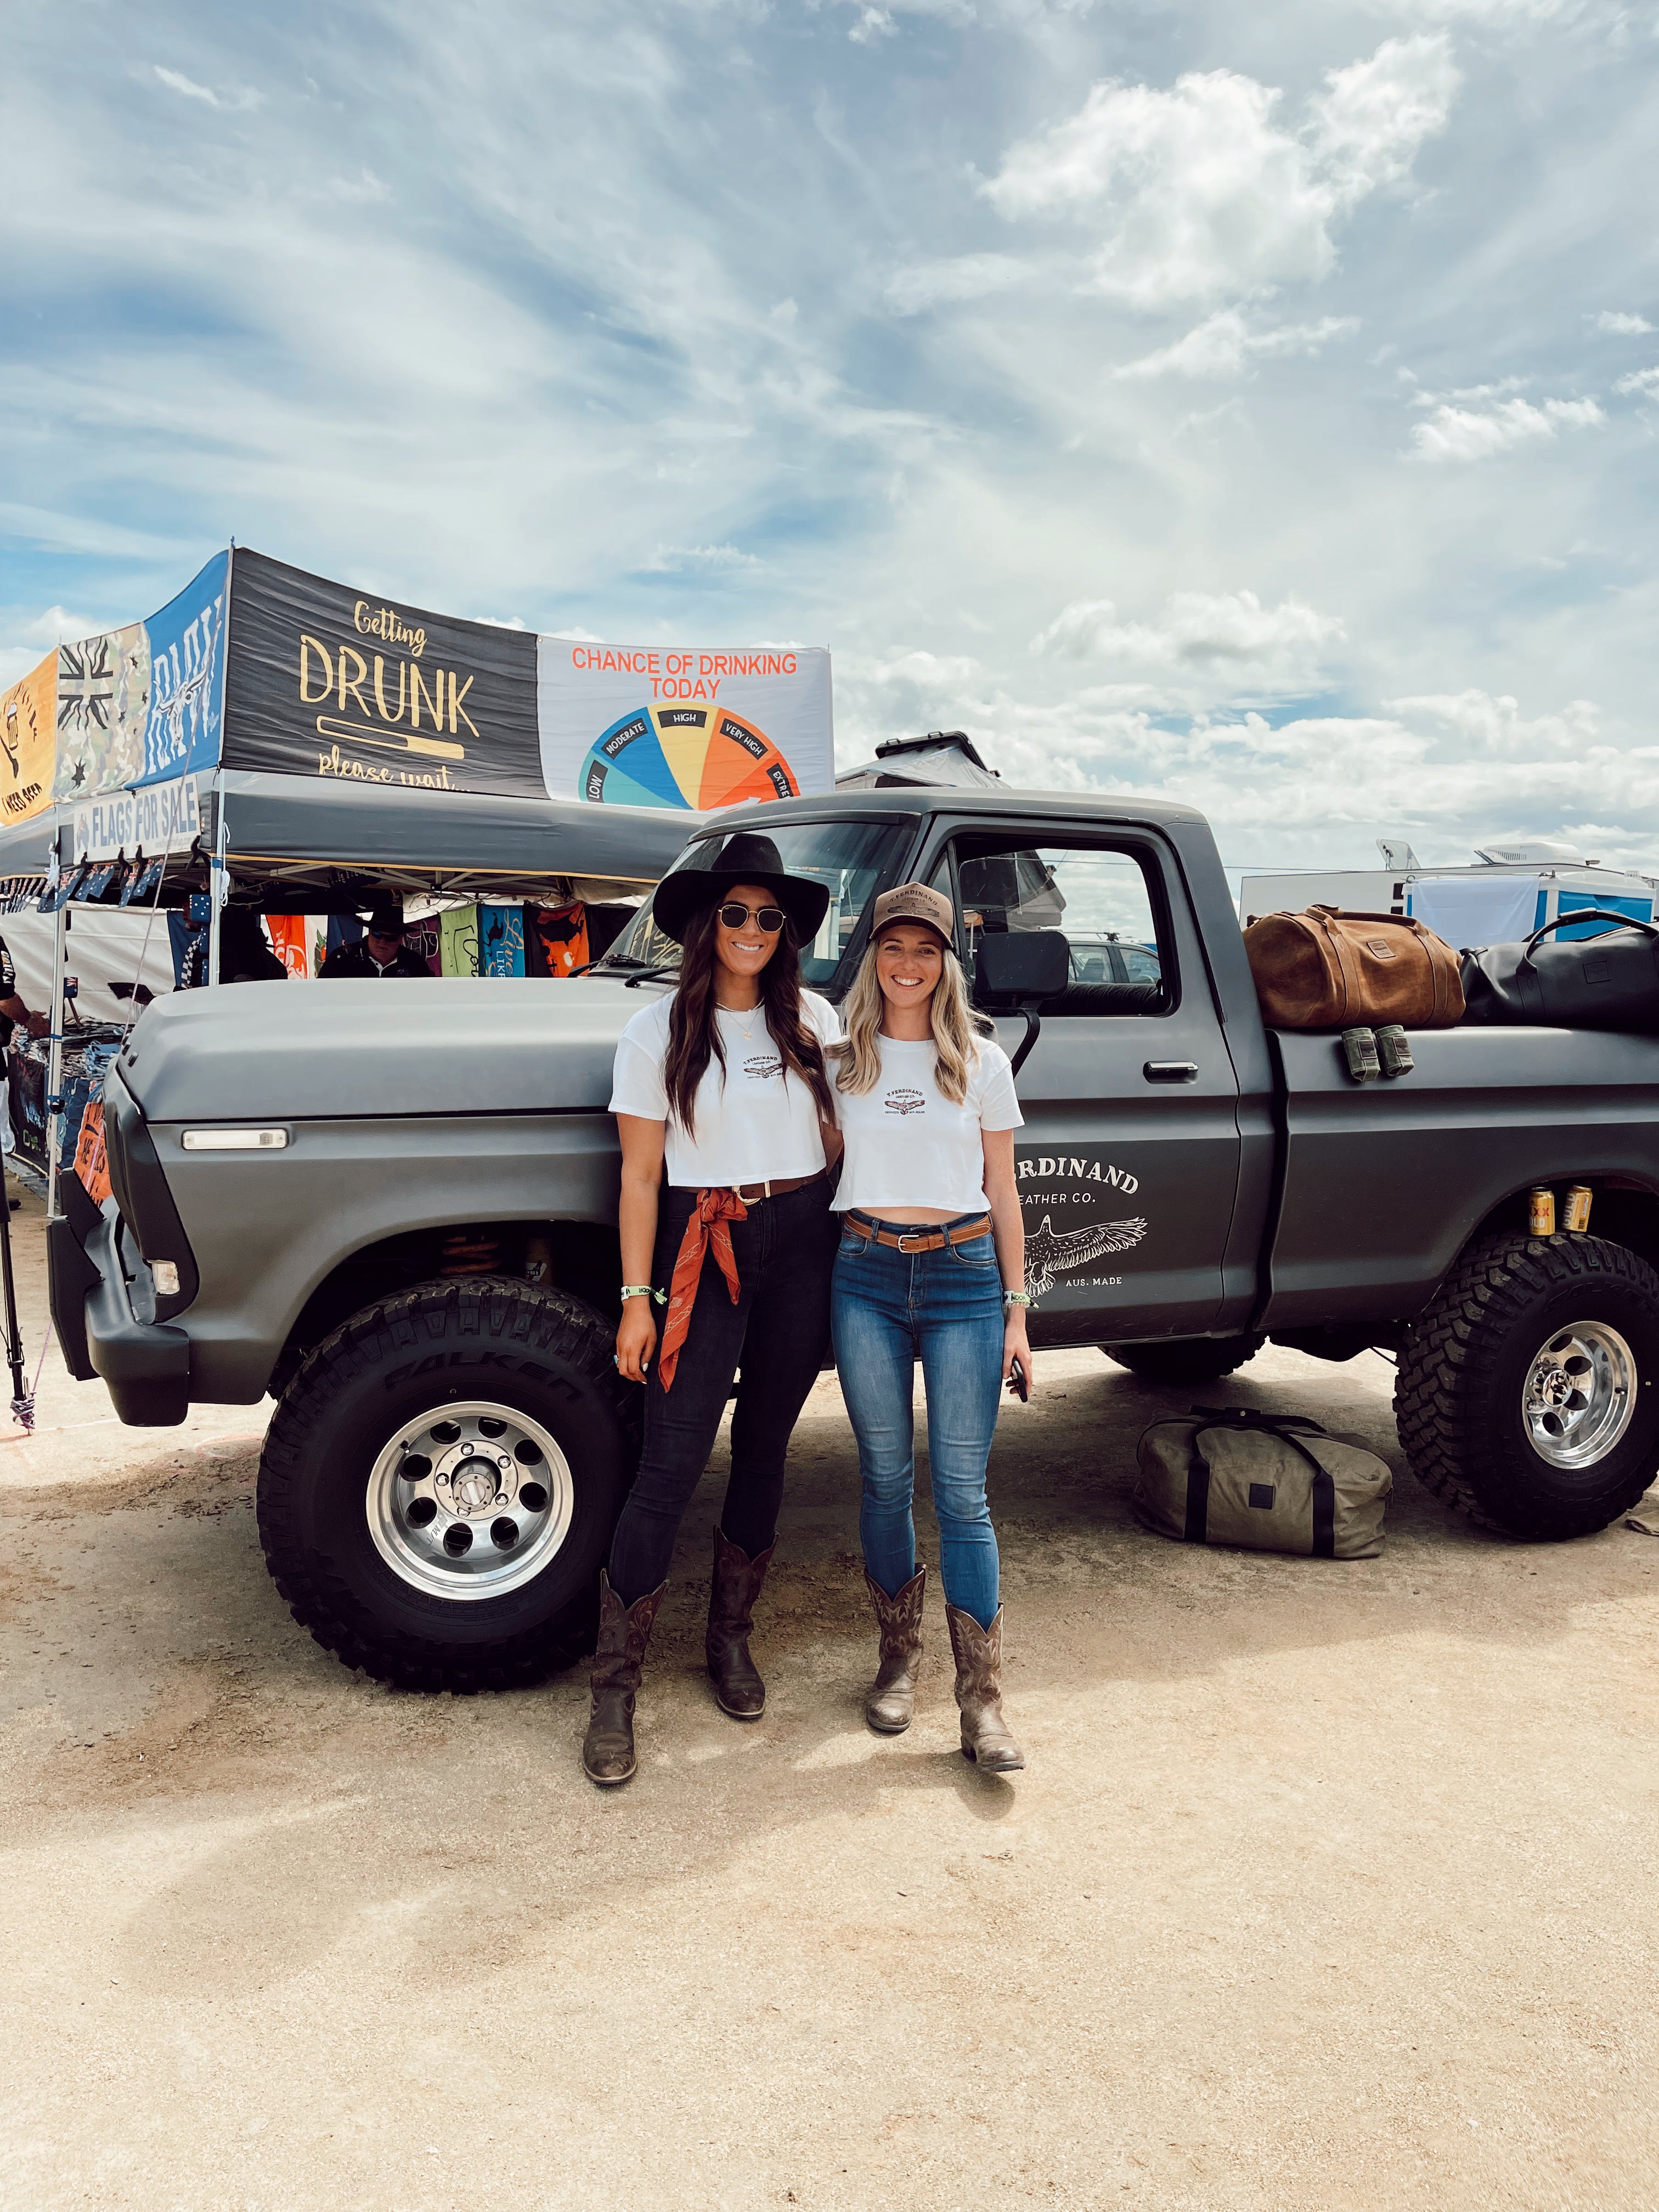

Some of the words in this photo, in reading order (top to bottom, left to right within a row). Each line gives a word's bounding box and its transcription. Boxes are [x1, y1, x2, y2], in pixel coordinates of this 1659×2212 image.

[354, 600, 427, 658] Getting
[572, 647, 659, 674] CHANCE
[665, 654, 693, 675] OF
[699, 653, 797, 675] DRINKING
[300, 634, 480, 737] DRUNK
[649, 677, 721, 699] TODAY
[673, 713, 697, 723] HIGH
[605, 722, 645, 755] MODERATE
[725, 723, 744, 740] VERY
[745, 736, 763, 756] HIGH
[318, 744, 394, 783] please
[588, 774, 603, 800] LOW
[772, 770, 791, 798] EXTRE
[92, 800, 132, 848] FLAGS
[136, 793, 159, 842] FOR
[162, 782, 196, 837] SALE
[889, 890, 938, 906] T.FERDINAND
[1014, 1157, 1139, 1194] RDINAND
[1019, 1194, 1067, 1205] EATHER
[1072, 1192, 1096, 1204] CO.
[1528, 1217, 1545, 1227] OLD
[1065, 1278, 1089, 1287] AUS.
[1092, 1277, 1122, 1285] MADE
